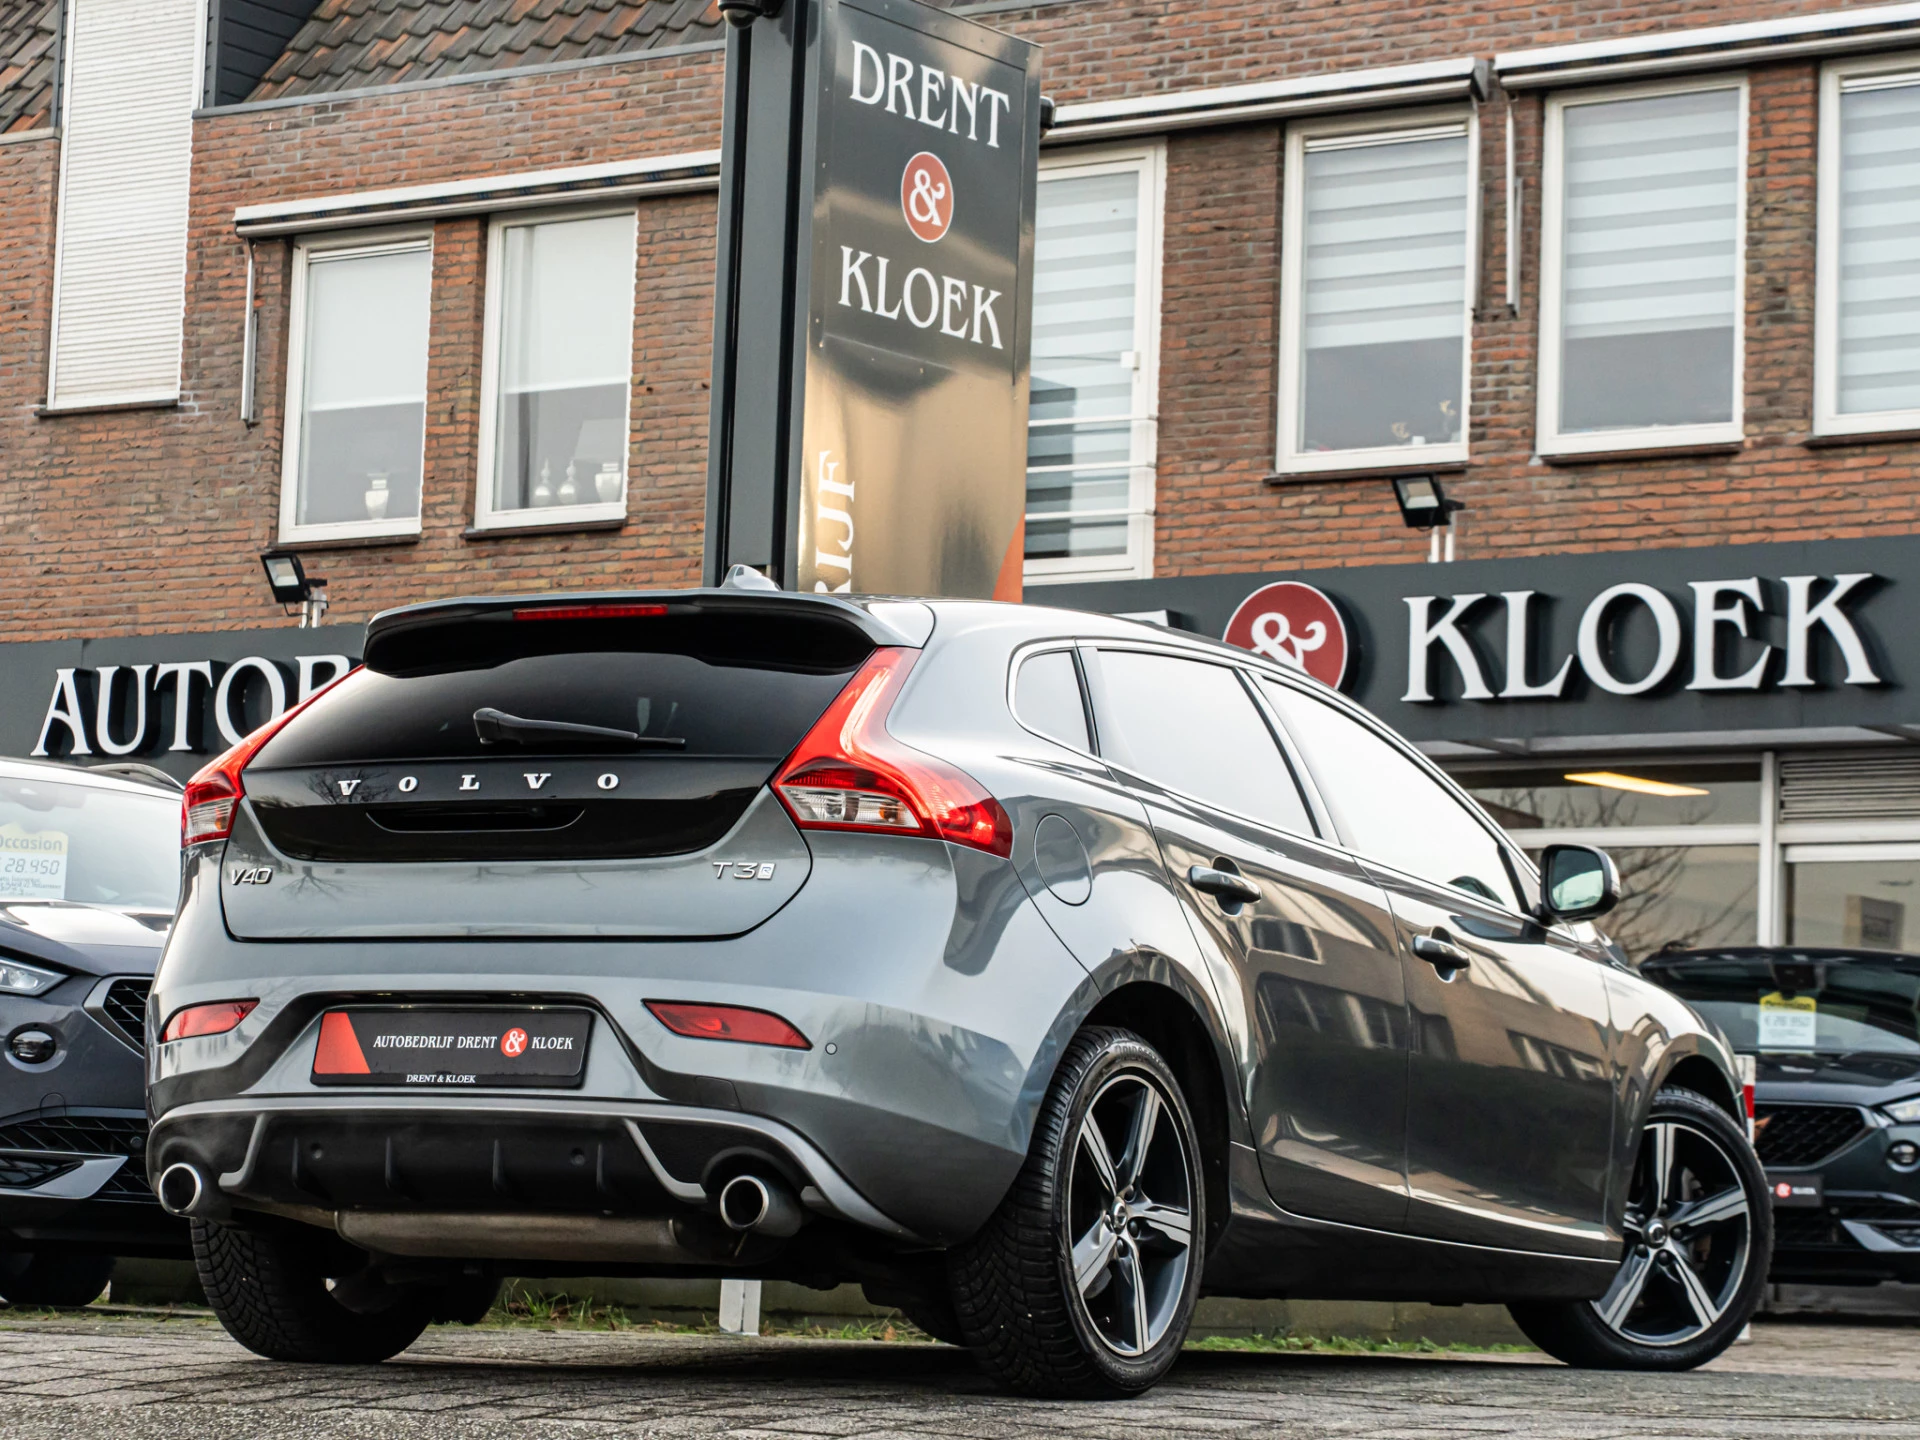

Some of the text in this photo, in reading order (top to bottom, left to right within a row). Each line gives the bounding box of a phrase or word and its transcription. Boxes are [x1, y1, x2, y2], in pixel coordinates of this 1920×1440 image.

[850, 40, 1010, 148] DRENT
[909, 168, 946, 227] &
[838, 245, 1003, 350] KLOEK
[1250, 573, 1881, 702] & KLOEK
[338, 773, 619, 796] VOLVO
[231, 867, 273, 885] V40
[373, 1030, 574, 1053] AUTOBEDRIJF DRENT & KLOEK
[406, 1074, 476, 1084] DRENT & KLOEK
